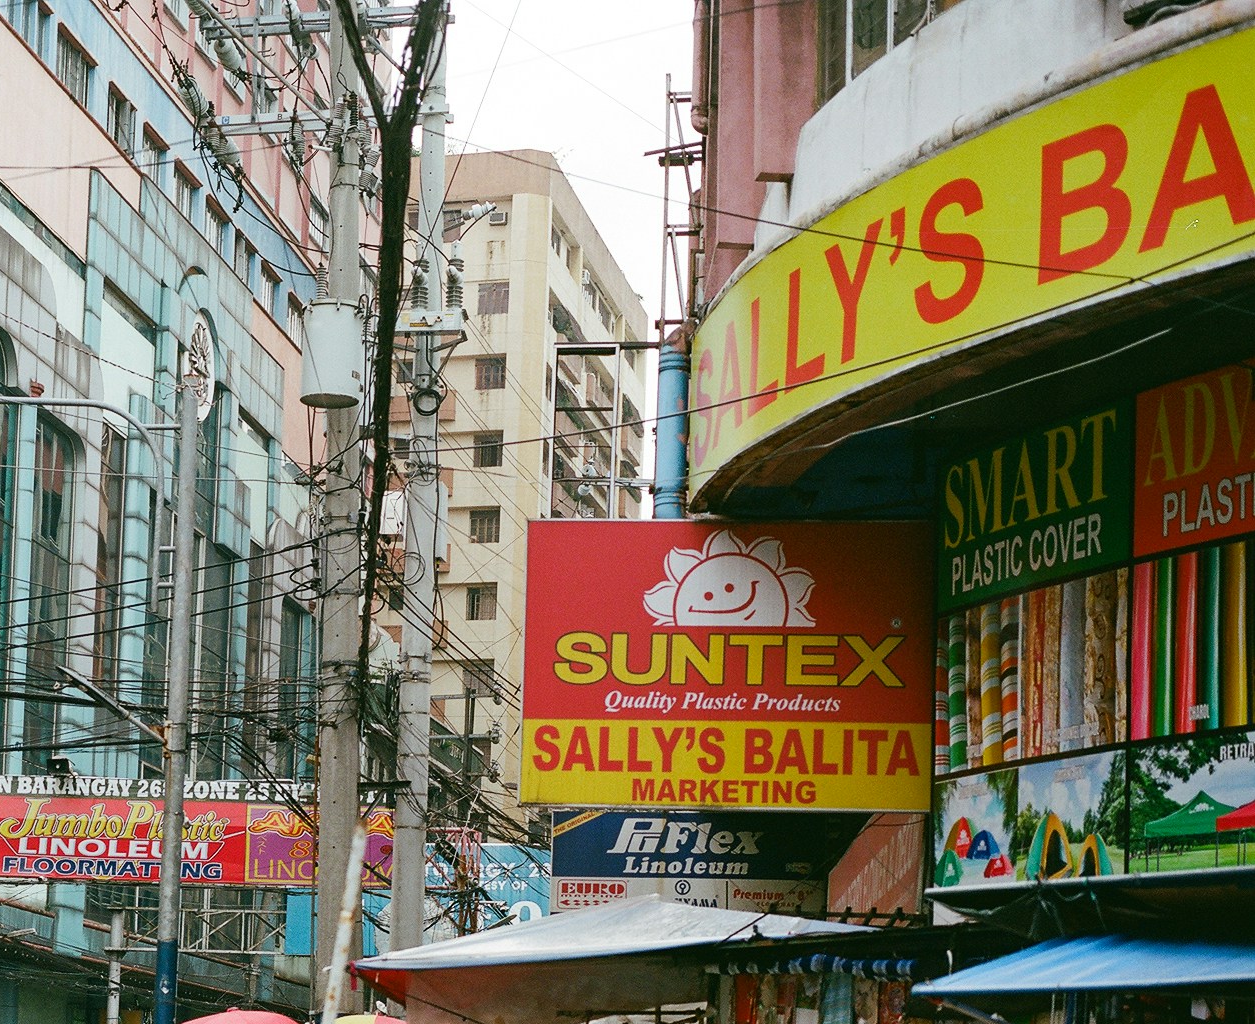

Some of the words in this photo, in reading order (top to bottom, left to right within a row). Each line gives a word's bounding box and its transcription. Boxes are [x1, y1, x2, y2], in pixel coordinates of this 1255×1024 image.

[694, 177, 985, 468] SALLY'S
[1037, 84, 1255, 286] BA
[1144, 372, 1255, 487] ADV
[945, 409, 1117, 549] SMART
[951, 535, 1023, 596] PLASTIC
[1028, 513, 1103, 572] COVER
[553, 631, 906, 688] SUNTEX
[604, 690, 677, 713] Quality
[681, 691, 746, 711] Plastic
[752, 692, 840, 713] Products
[532, 725, 726, 774] SALLY'S
[745, 728, 920, 777] BALITA
[16, 776, 134, 799] BARANGAY
[136, 780, 166, 798] 26
[183, 781, 240, 801] ZONE
[632, 779, 817, 805] MARKETING
[2, 855, 222, 880] FLOORMATTNG
[623, 856, 749, 876] Linoleum
[561, 882, 625, 895] EURO
[733, 888, 784, 901] Premium
